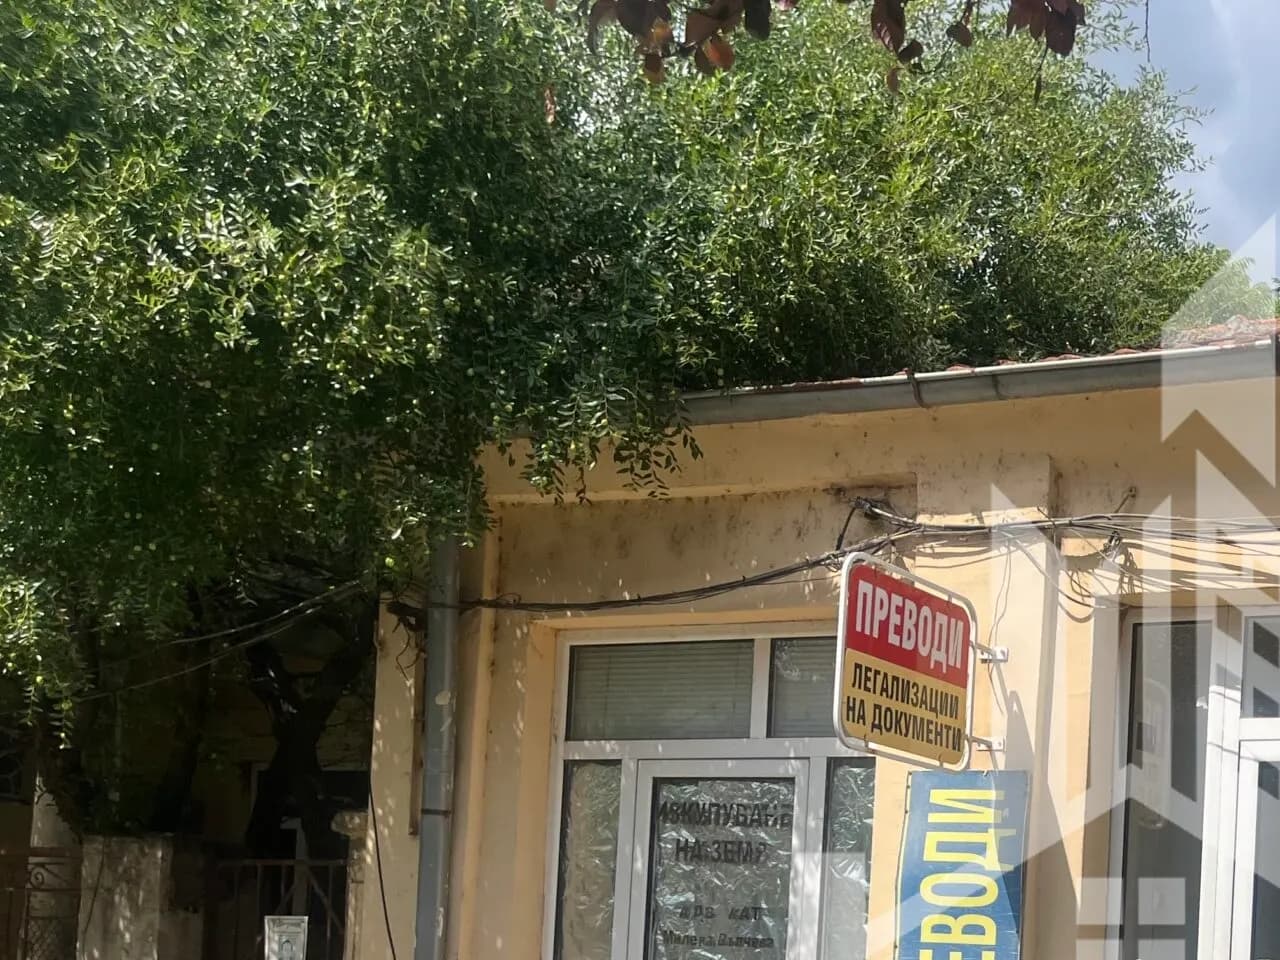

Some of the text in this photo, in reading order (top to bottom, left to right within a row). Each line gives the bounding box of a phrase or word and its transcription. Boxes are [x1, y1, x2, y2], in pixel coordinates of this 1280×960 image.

[855, 579, 964, 673] ПРЕВОДИ
[851, 662, 960, 720] ЛЕГАЛИЗАЦИИ
[846, 696, 961, 752] НА ДОКУМЕНТИ
[675, 838, 703, 862] НА
